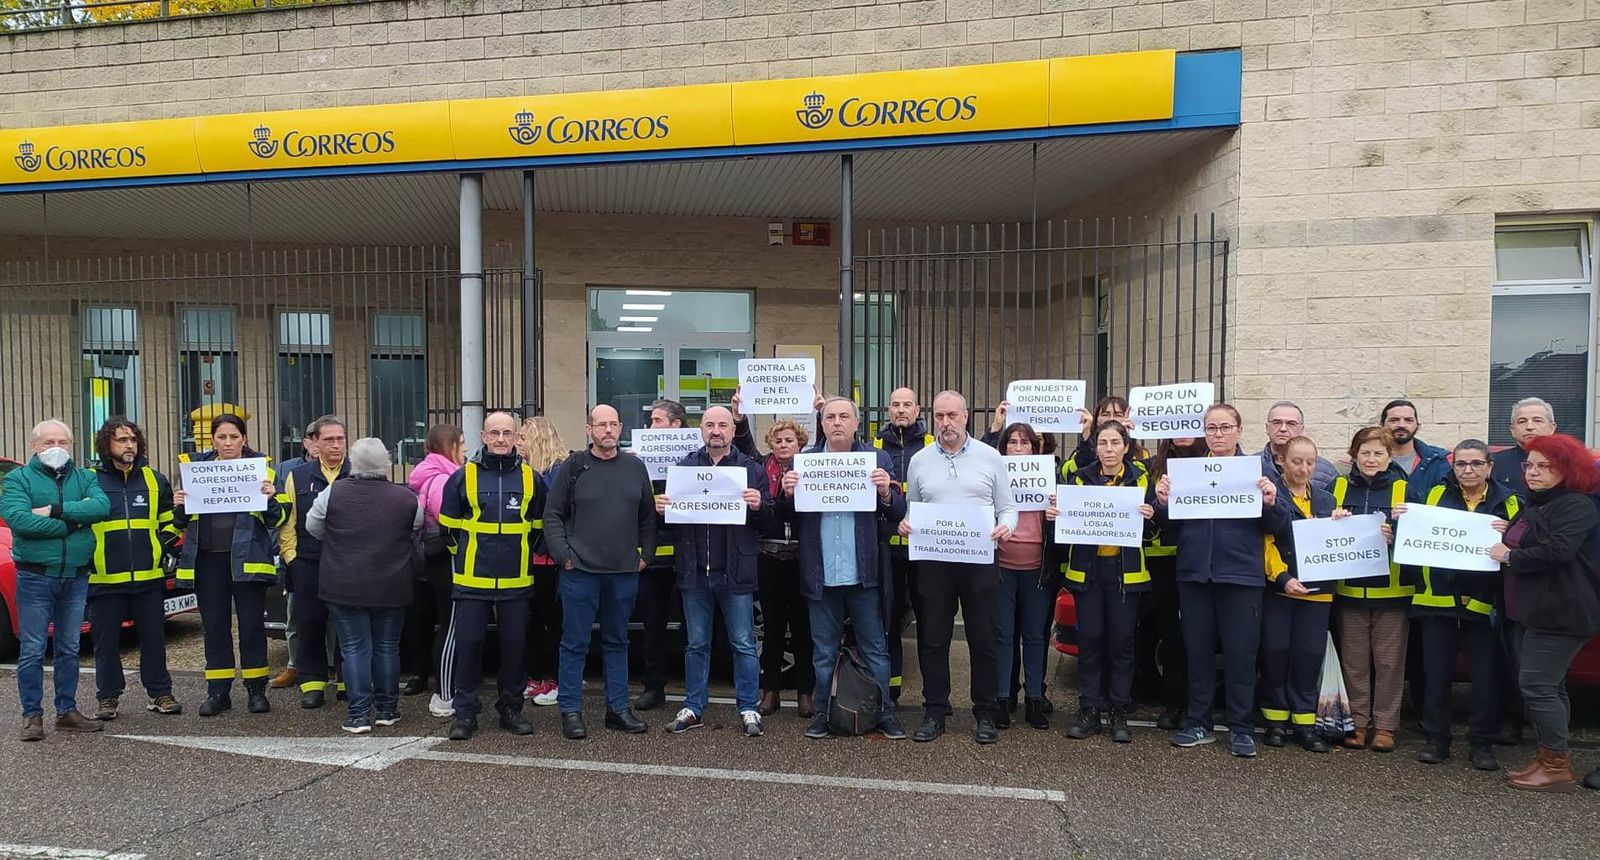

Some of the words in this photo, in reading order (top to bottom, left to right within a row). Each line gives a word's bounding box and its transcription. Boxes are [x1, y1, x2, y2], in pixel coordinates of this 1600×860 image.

[838, 95, 977, 126] CORREOS
[546, 115, 669, 143] CORREOS
[283, 130, 395, 157] CORREOS
[46, 145, 146, 170] CORREOS
[746, 363, 785, 372] CONTRA
[788, 364, 806, 372] LAS
[746, 374, 807, 384] AGRESIONES
[763, 386, 776, 395] EN
[779, 386, 789, 395] EL
[1035, 384, 1079, 392] NUESTRA
[1018, 395, 1064, 403] DIGNIDAD
[1145, 391, 1172, 401] POR
[1178, 389, 1196, 399] UN
[755, 397, 799, 406] REPARTO
[1016, 406, 1073, 414] INTEGRIDAD
[1138, 404, 1203, 416] REPARTO
[1030, 414, 1060, 424] FÍSICA
[1142, 420, 1201, 431] SEGURO
[641, 444, 698, 452] AGRESIONES
[803, 458, 845, 468] CONTRA
[848, 457, 866, 466] LAS
[191, 465, 233, 474] CONTRA
[236, 463, 256, 472] LAS
[1204, 464, 1222, 473] NO
[191, 474, 258, 485] AGRESIONES
[802, 470, 867, 480] AGRESIONES
[804, 482, 867, 492] TOLERANCIA
[1010, 478, 1046, 488] ARTO
[1210, 480, 1218, 488] +
[211, 486, 225, 495] EN
[228, 486, 240, 494] EL
[203, 496, 251, 506] REPARTO
[821, 495, 850, 504] CERO
[1175, 494, 1255, 505] AGRESIONES
[672, 502, 740, 510] AGRESIONES
[1068, 510, 1117, 519] SEGURIDAD
[1119, 511, 1130, 519] DE
[1084, 520, 1113, 528] LOS/AS
[920, 529, 968, 537] SEGURIDAD
[1061, 528, 1137, 539] TRABAJADORES/AS
[1432, 527, 1467, 538] STOP
[1325, 536, 1355, 548] STOP
[914, 546, 988, 555] TRABAJADORES/AS
[1304, 549, 1381, 565] AGRESIONES
